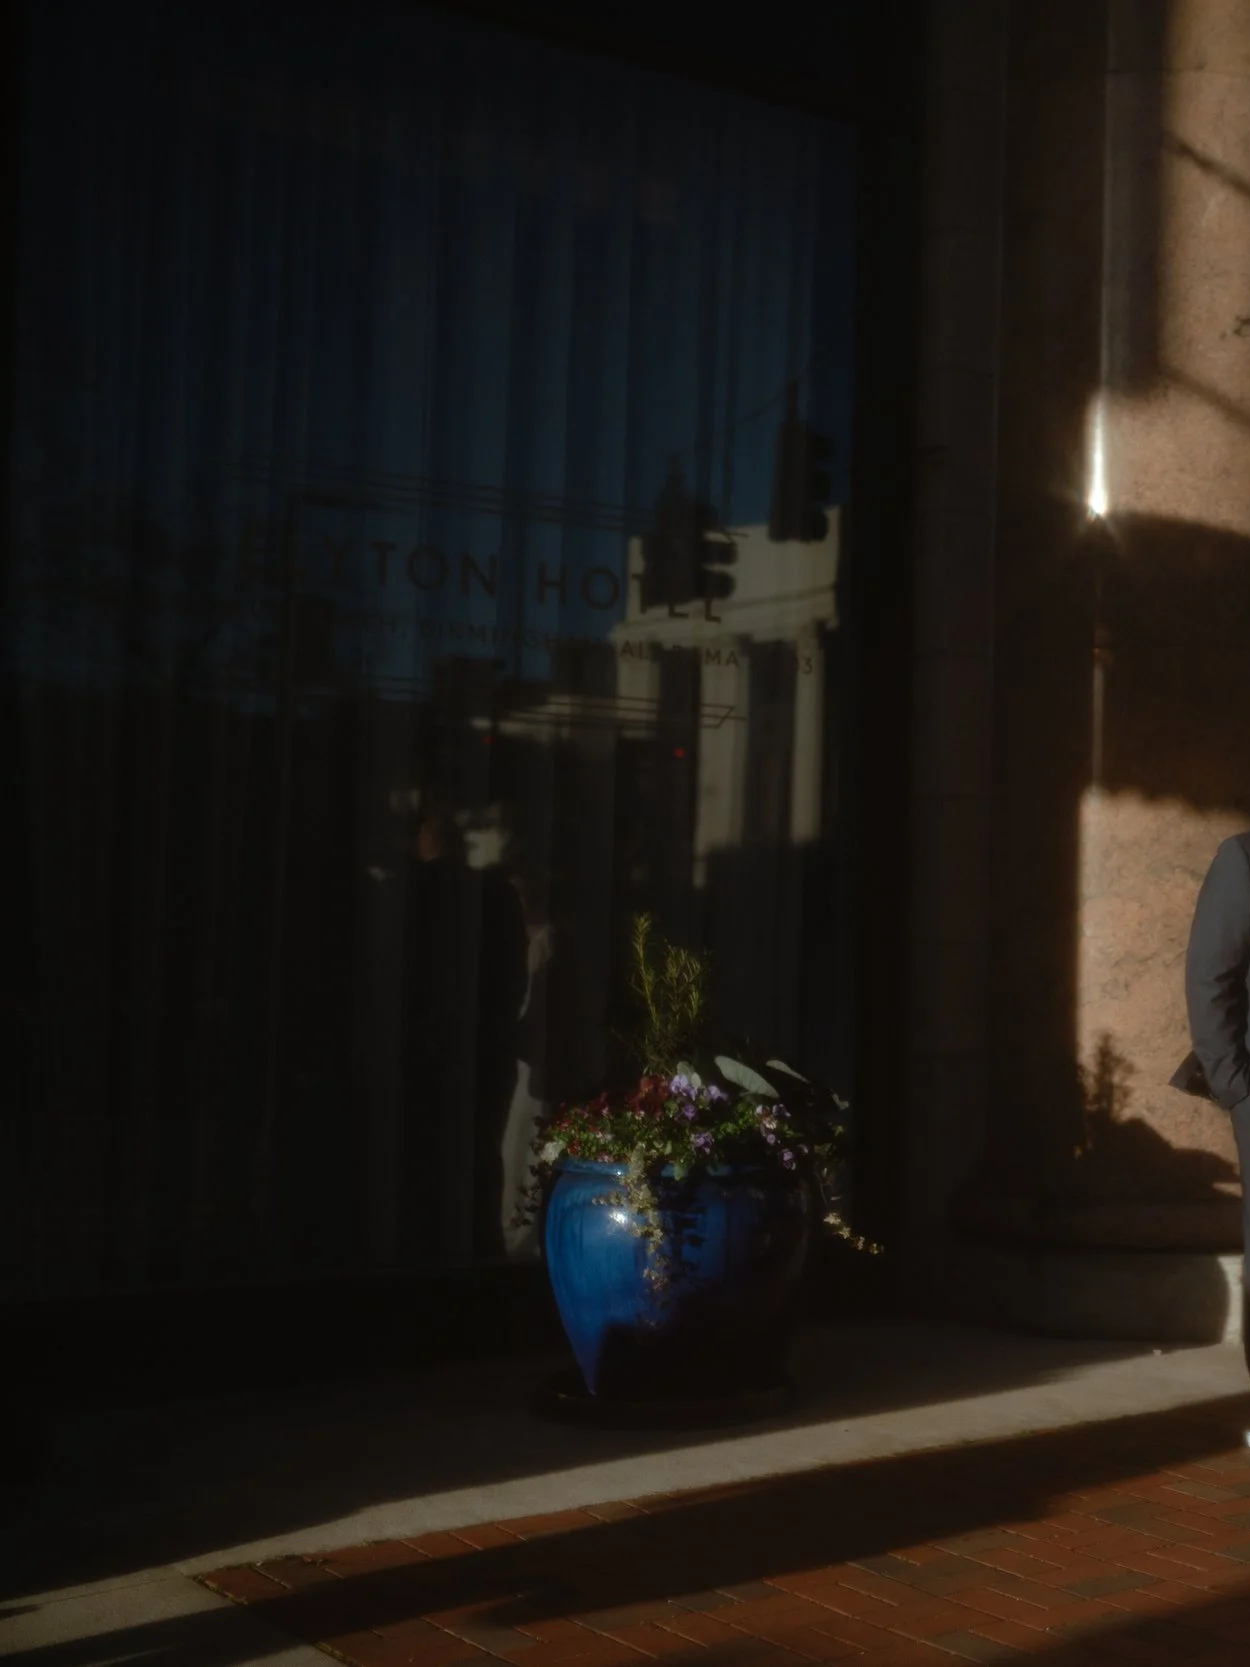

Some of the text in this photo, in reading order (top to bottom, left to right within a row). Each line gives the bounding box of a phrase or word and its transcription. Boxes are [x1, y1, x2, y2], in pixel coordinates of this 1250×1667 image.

[243, 520, 721, 623] EYTON HOTL
[619, 640, 740, 669] ALMA
